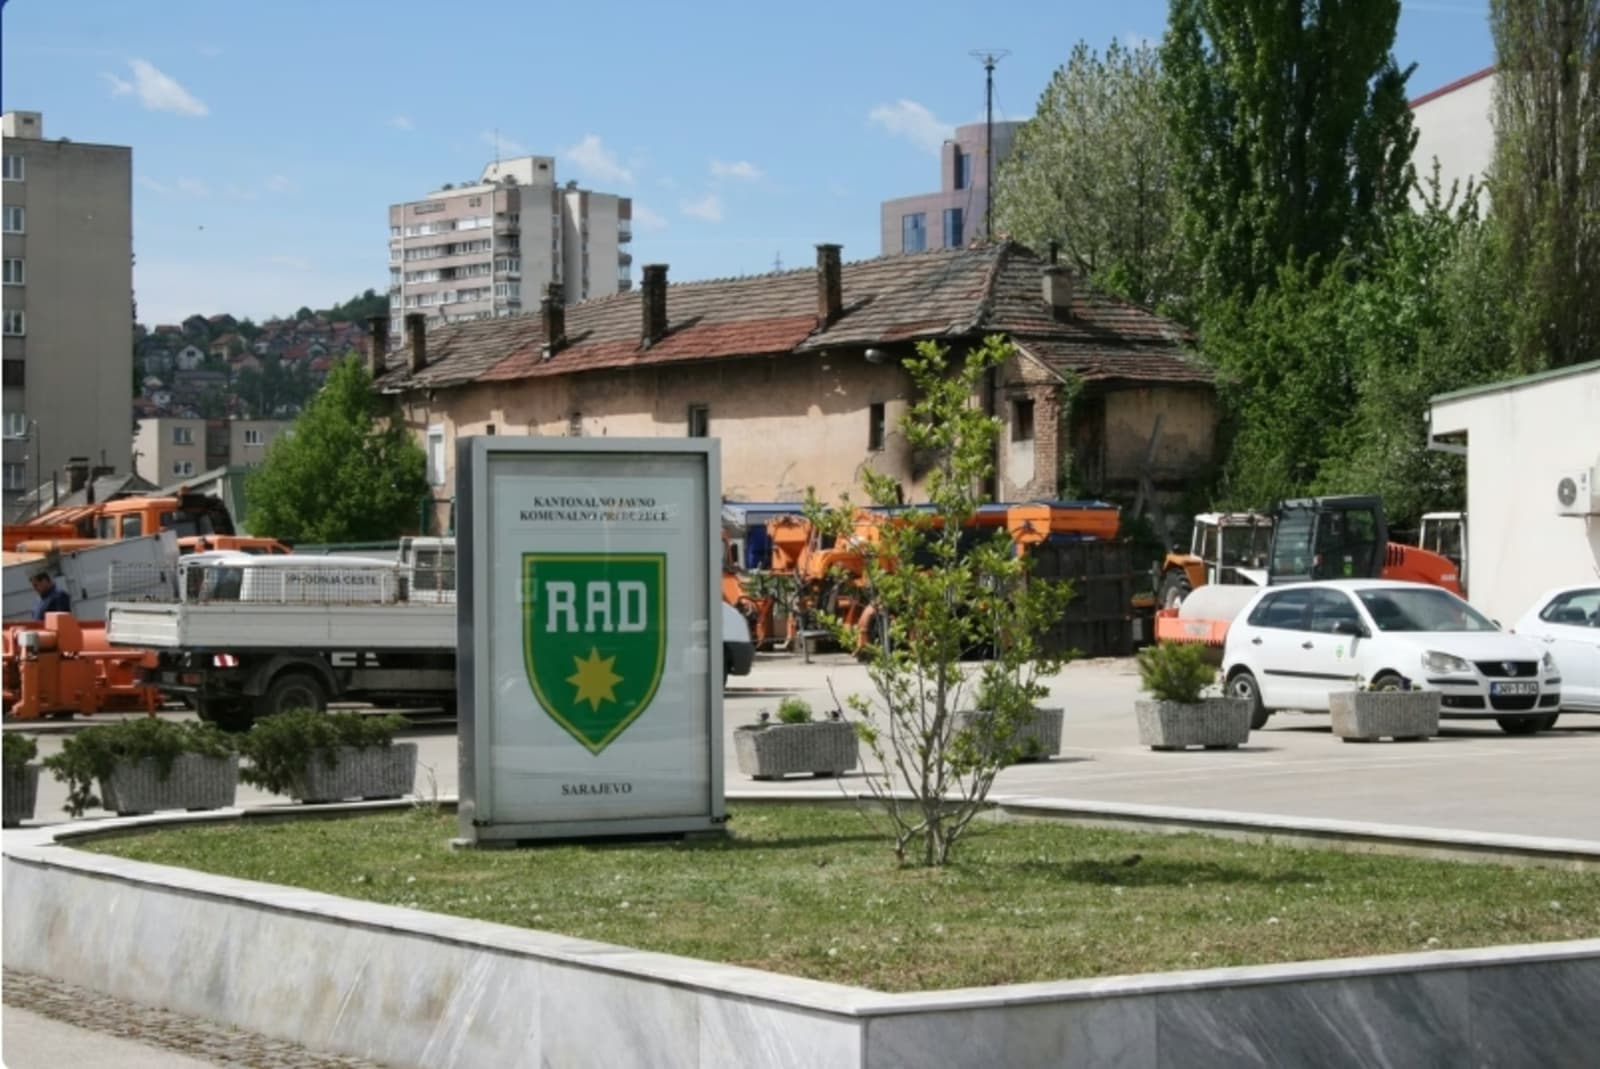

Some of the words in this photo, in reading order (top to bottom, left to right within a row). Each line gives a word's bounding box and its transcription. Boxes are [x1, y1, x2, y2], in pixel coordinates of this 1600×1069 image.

[533, 496, 616, 507] KANTONALNO
[618, 496, 656, 507] JAVNO
[520, 510, 597, 521] KOMUNALNO
[545, 581, 647, 632] RAD
[561, 782, 633, 796] SARAJEVO
